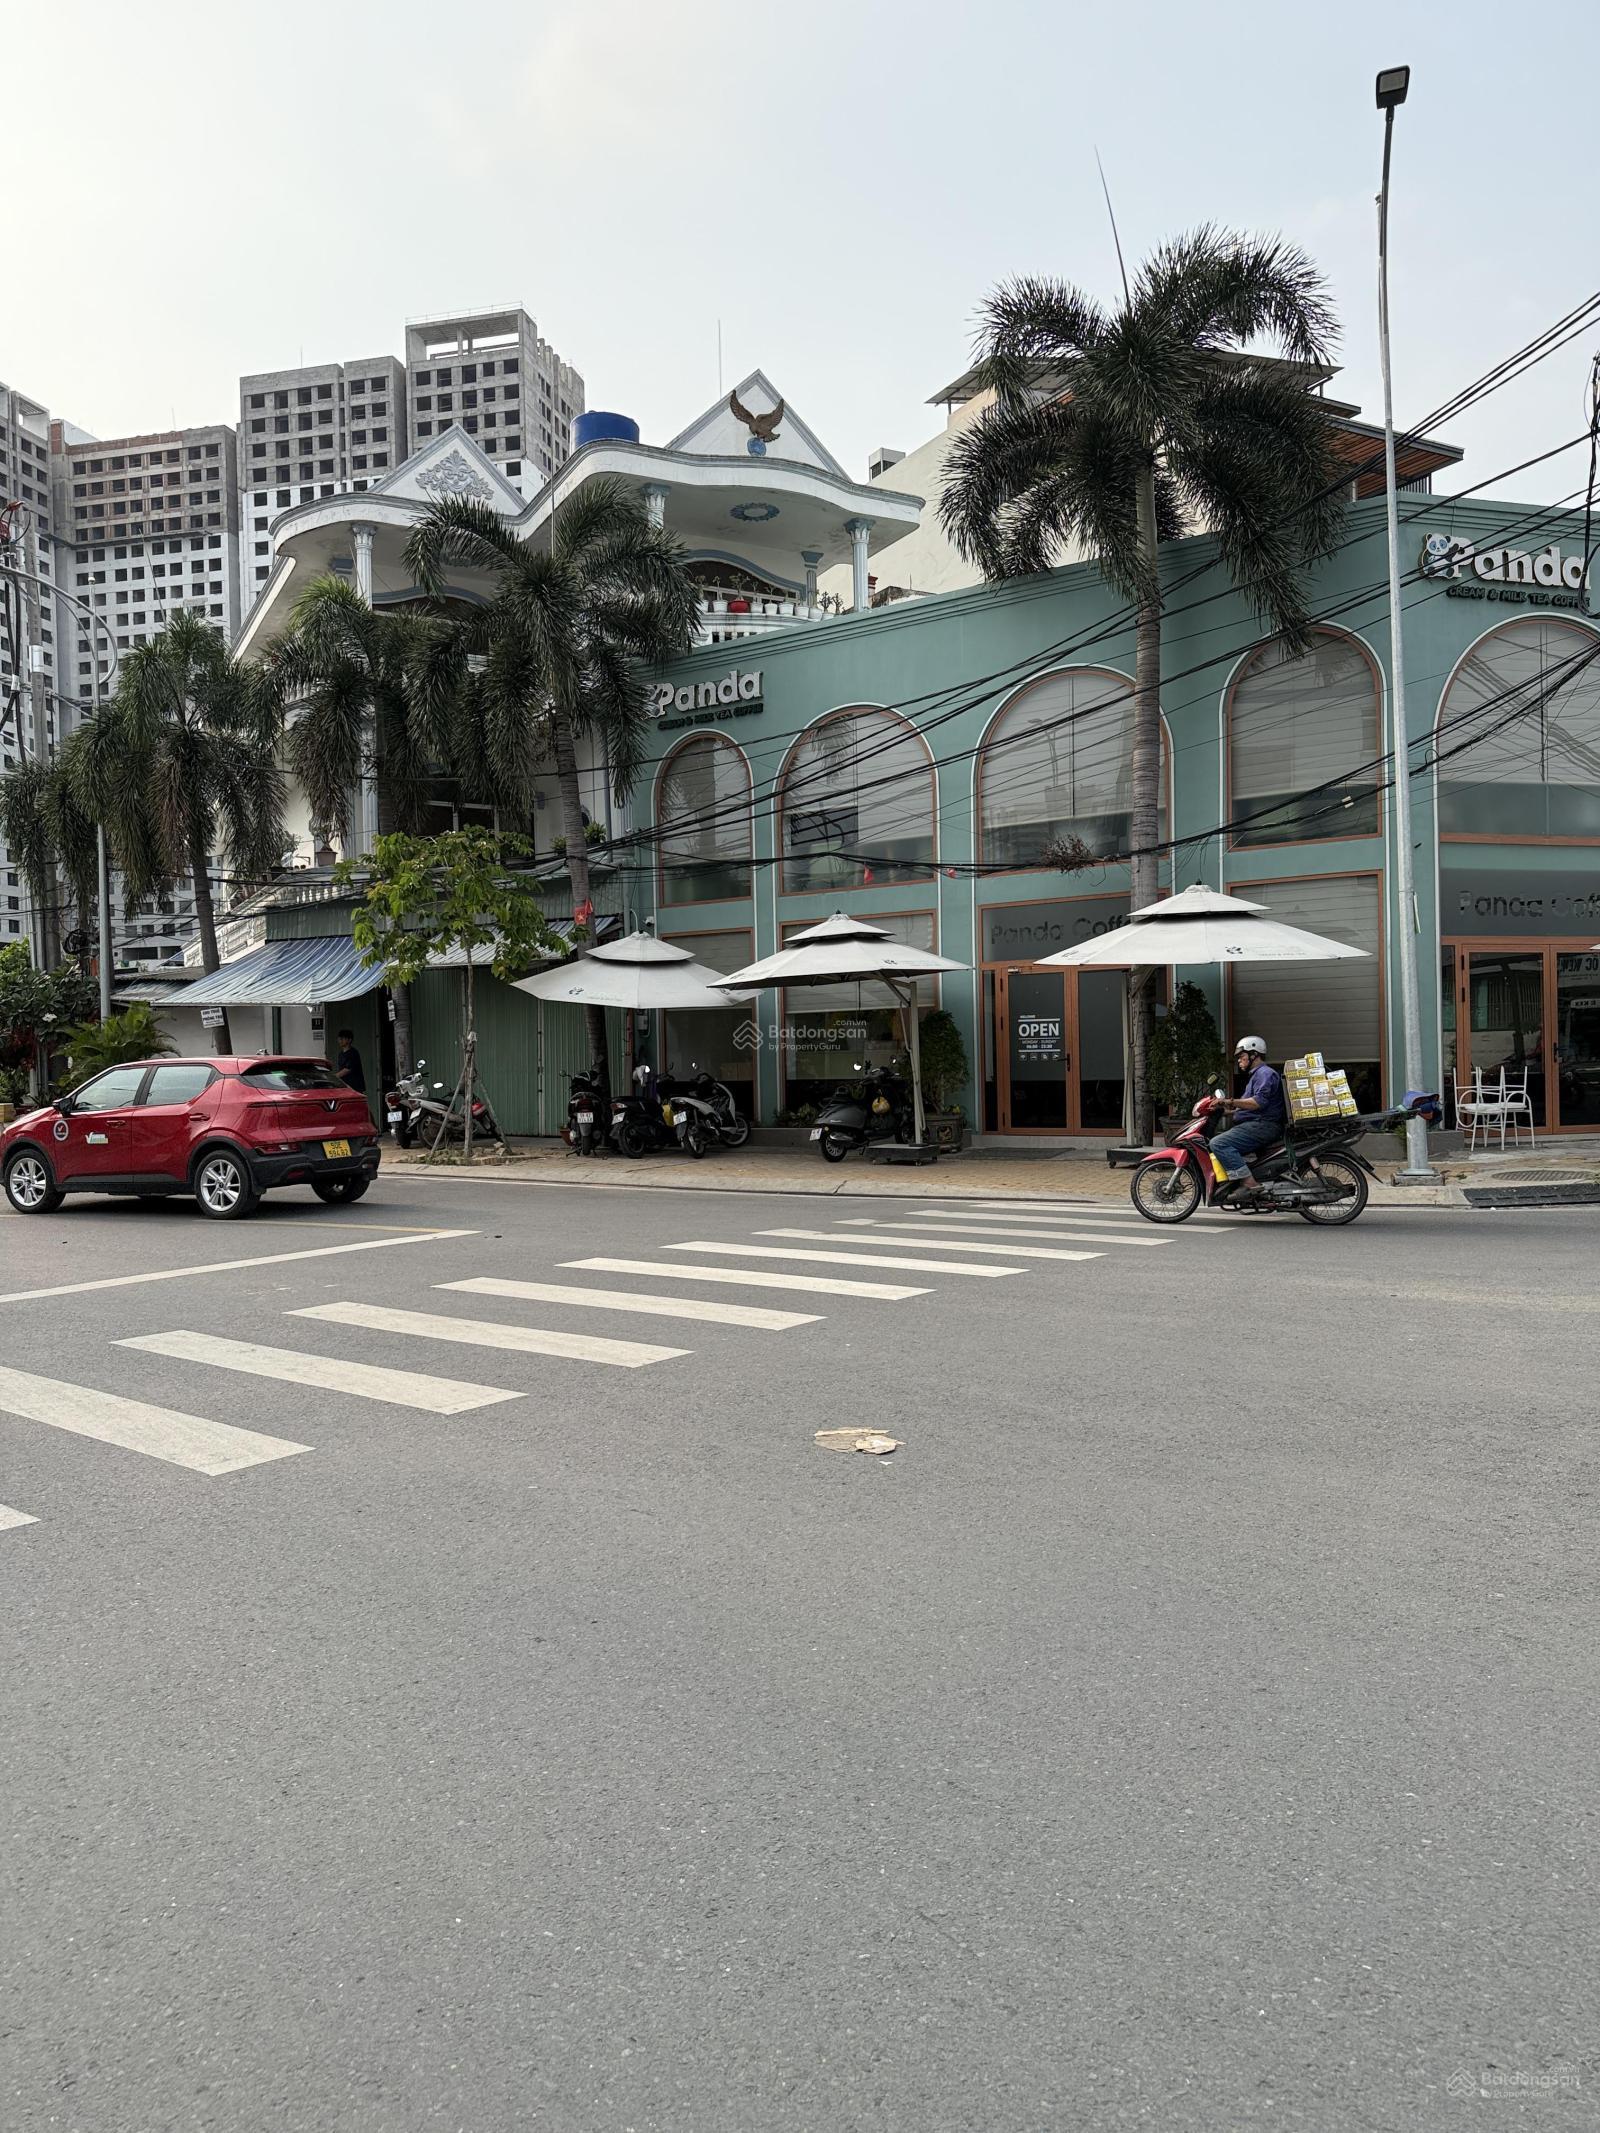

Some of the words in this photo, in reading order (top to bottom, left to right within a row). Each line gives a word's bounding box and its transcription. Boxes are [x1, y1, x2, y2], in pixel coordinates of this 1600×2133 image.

[1450, 536, 1591, 590] Panda
[1448, 585, 1486, 600] CREAM
[1502, 589, 1528, 602] MILK
[1531, 593, 1551, 604] TEA
[657, 670, 761, 716] Panda
[1459, 890, 1543, 918] Panda
[991, 921, 1064, 945] Panda
[1018, 1023, 1060, 1037] OPEN
